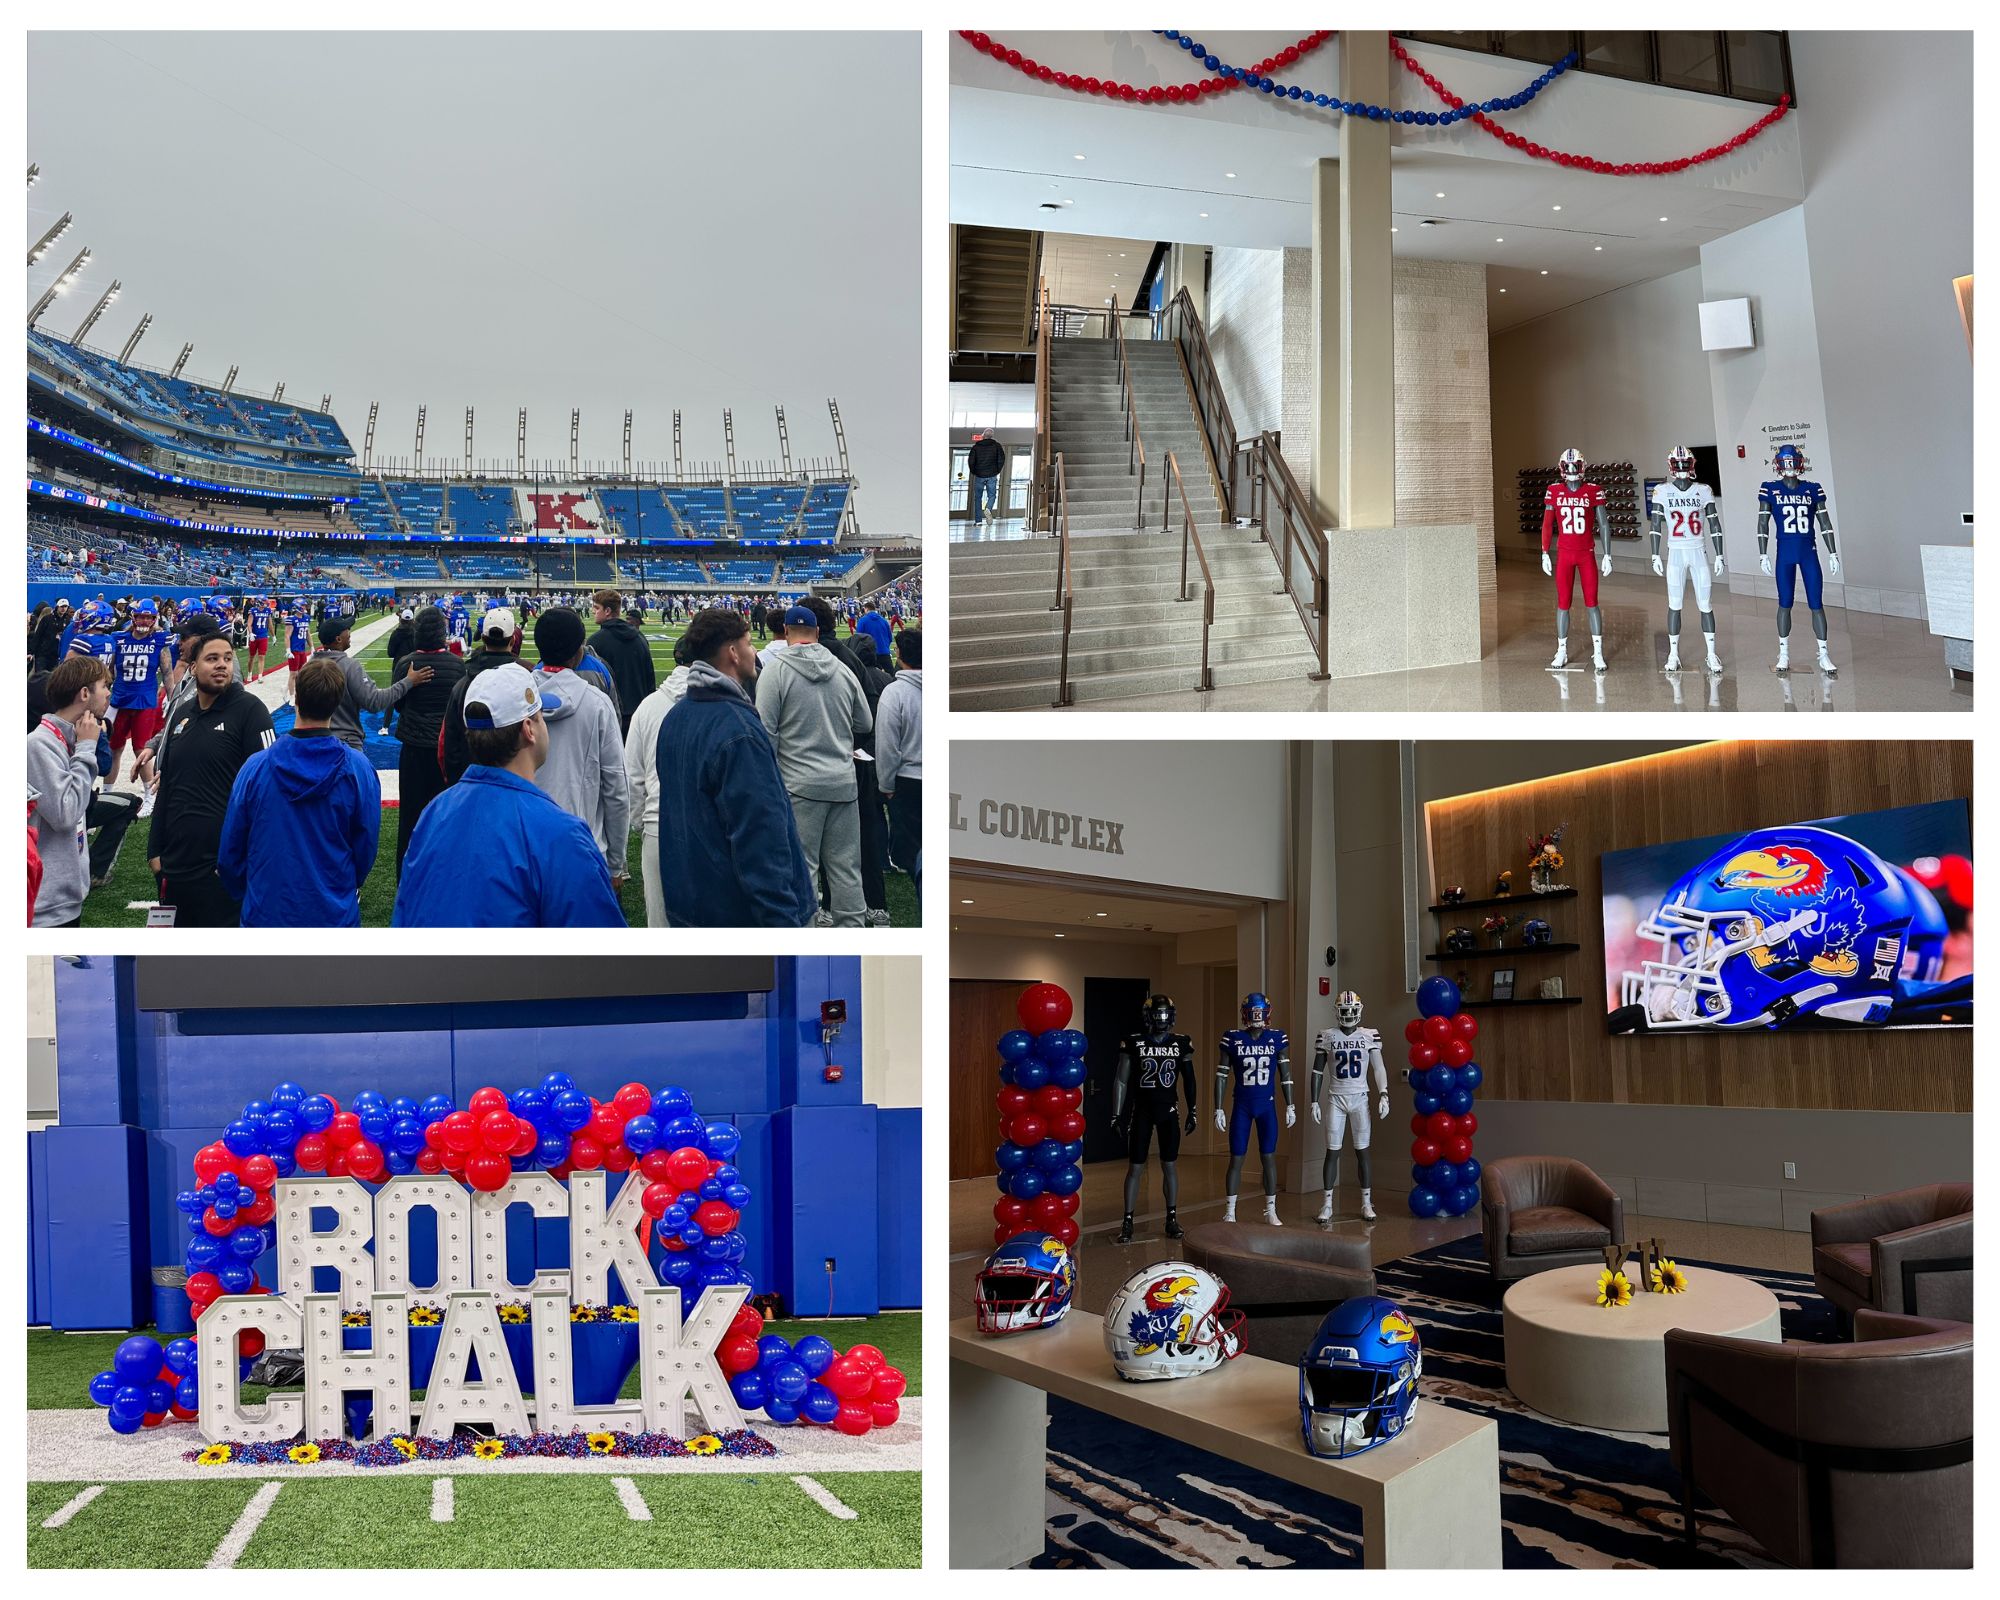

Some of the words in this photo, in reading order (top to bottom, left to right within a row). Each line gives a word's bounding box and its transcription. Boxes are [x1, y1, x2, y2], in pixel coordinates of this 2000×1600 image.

[1556, 497, 1590, 507] KANSAS
[1668, 498, 1701, 508] KANSAS
[1775, 495, 1812, 505] KANSAS
[180, 520, 203, 529] DAVID
[205, 524, 229, 532] BOOTH
[233, 527, 268, 536] KANSAS
[272, 529, 319, 538] MEMORIAL
[324, 532, 366, 540] STADIUM
[1560, 507, 1586, 534] 26
[1670, 510, 1702, 537] 26
[1782, 505, 1809, 533] 26
[256, 618, 266, 628] 44
[120, 644, 155, 654] KANSAS
[123, 655, 149, 682] 58
[978, 799, 1124, 855] COMPLEX
[1139, 1046, 1180, 1057] KANSAS
[1237, 1045, 1275, 1056] KANSAS
[1331, 1040, 1366, 1050] KANSAS
[1139, 1058, 1176, 1088] 26
[1243, 1056, 1271, 1086] 26
[1335, 1049, 1362, 1079] 26
[275, 1170, 661, 1311] ROCK
[1147, 1315, 1169, 1335] KU
[197, 1285, 753, 1443] CHALK
